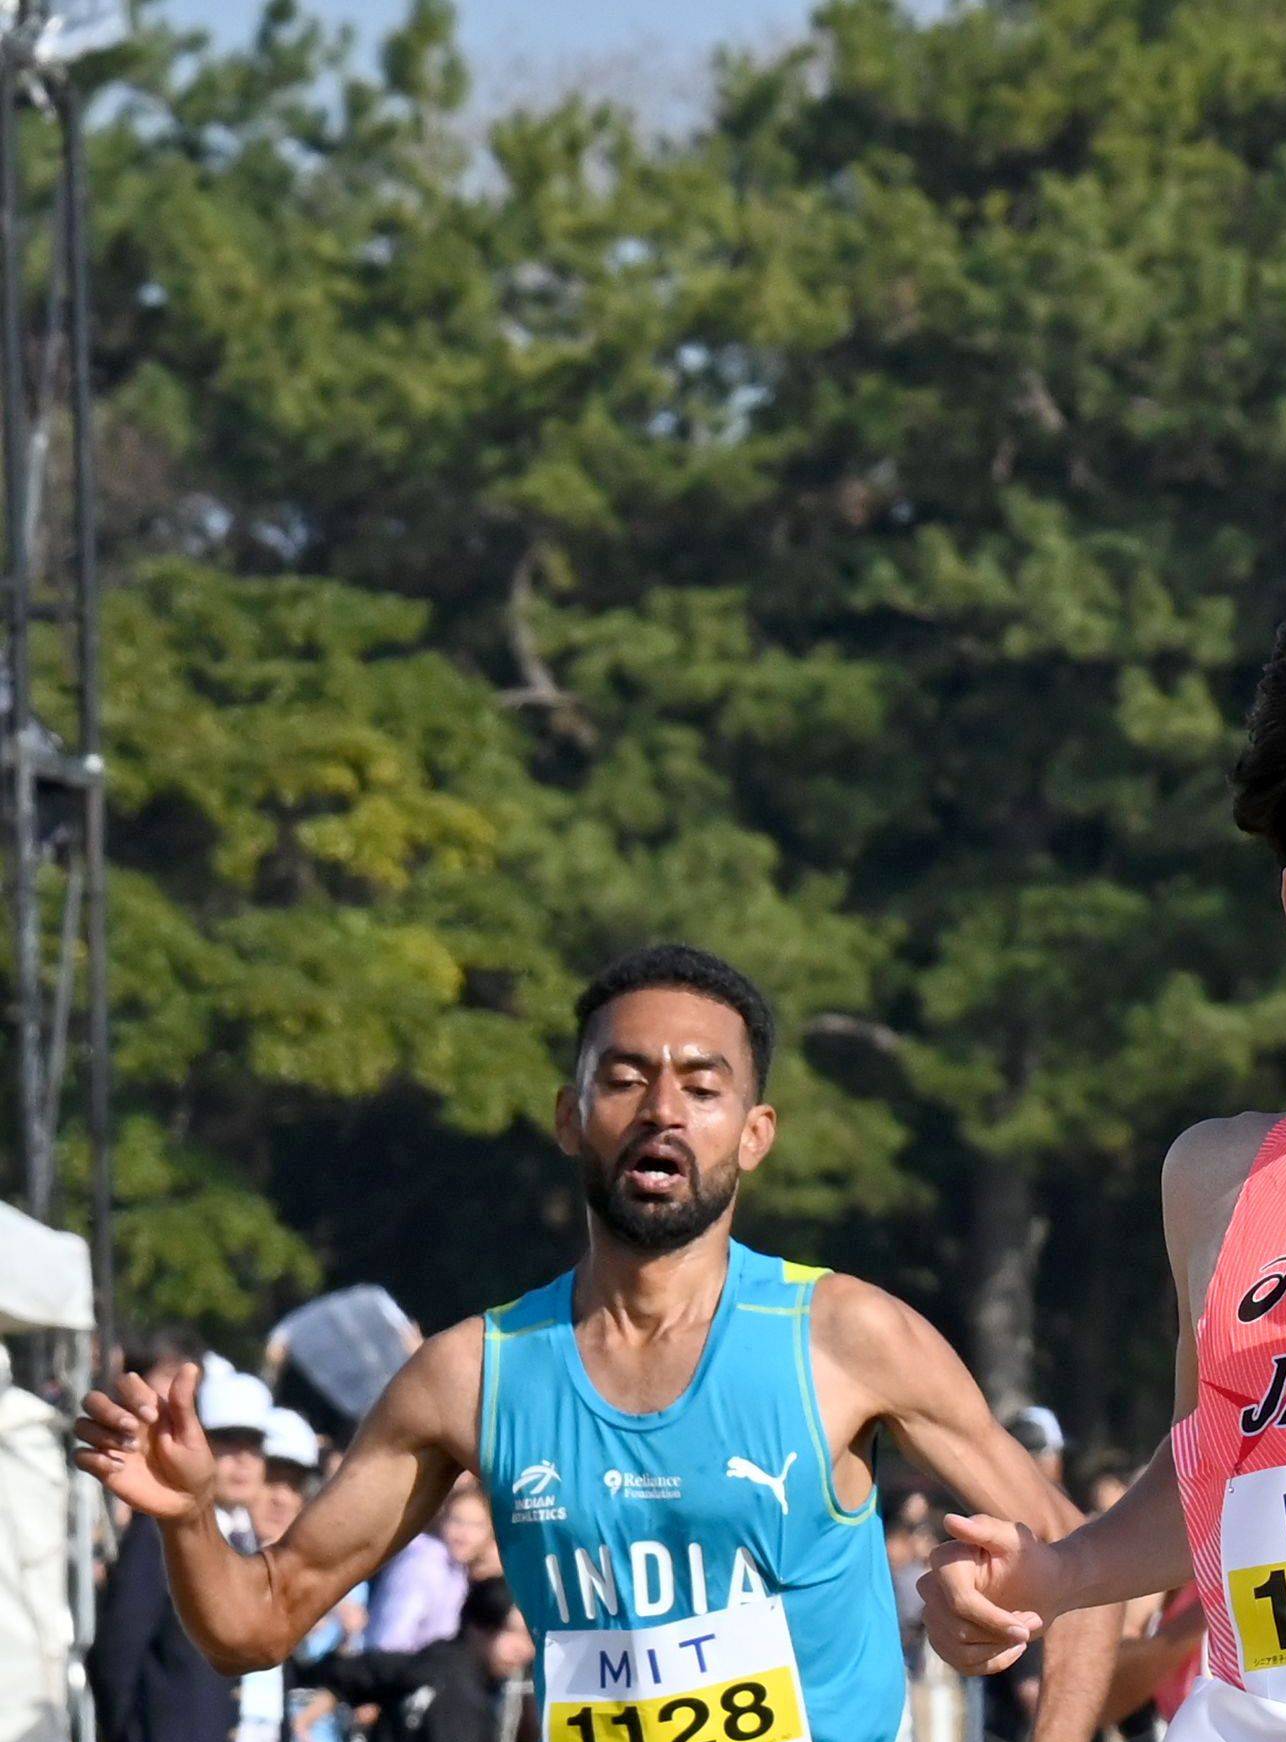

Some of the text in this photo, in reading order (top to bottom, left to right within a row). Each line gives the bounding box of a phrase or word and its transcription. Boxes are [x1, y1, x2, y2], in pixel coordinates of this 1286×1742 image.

[623, 1472, 682, 1487] Reliance
[623, 1487, 682, 1499] Foundation
[545, 1541, 767, 1624] INDIA
[600, 1633, 716, 1689] MIT
